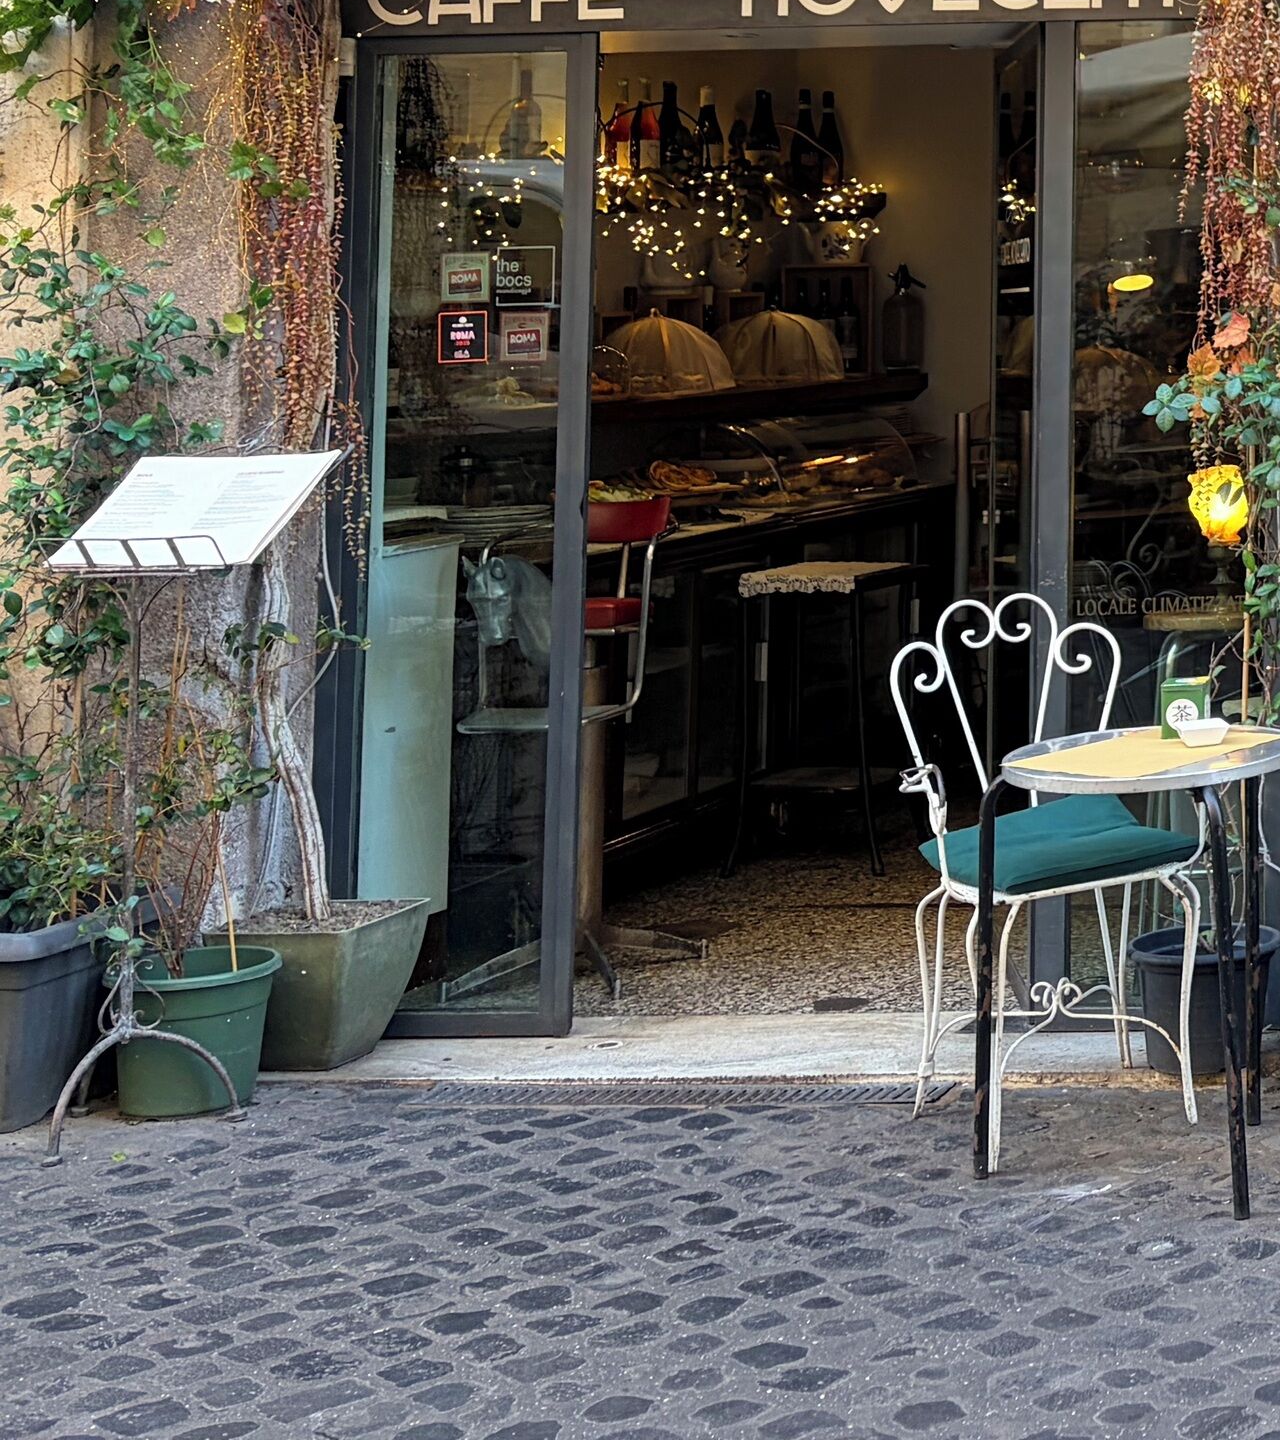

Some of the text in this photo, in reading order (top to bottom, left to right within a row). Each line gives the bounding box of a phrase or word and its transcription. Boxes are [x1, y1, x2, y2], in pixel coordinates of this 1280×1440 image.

[497, 259, 519, 272] the
[496, 274, 532, 287] bocs
[510, 333, 537, 344] ROMA
[1076, 594, 1246, 617] LOCALE CLIMATIZZAT
